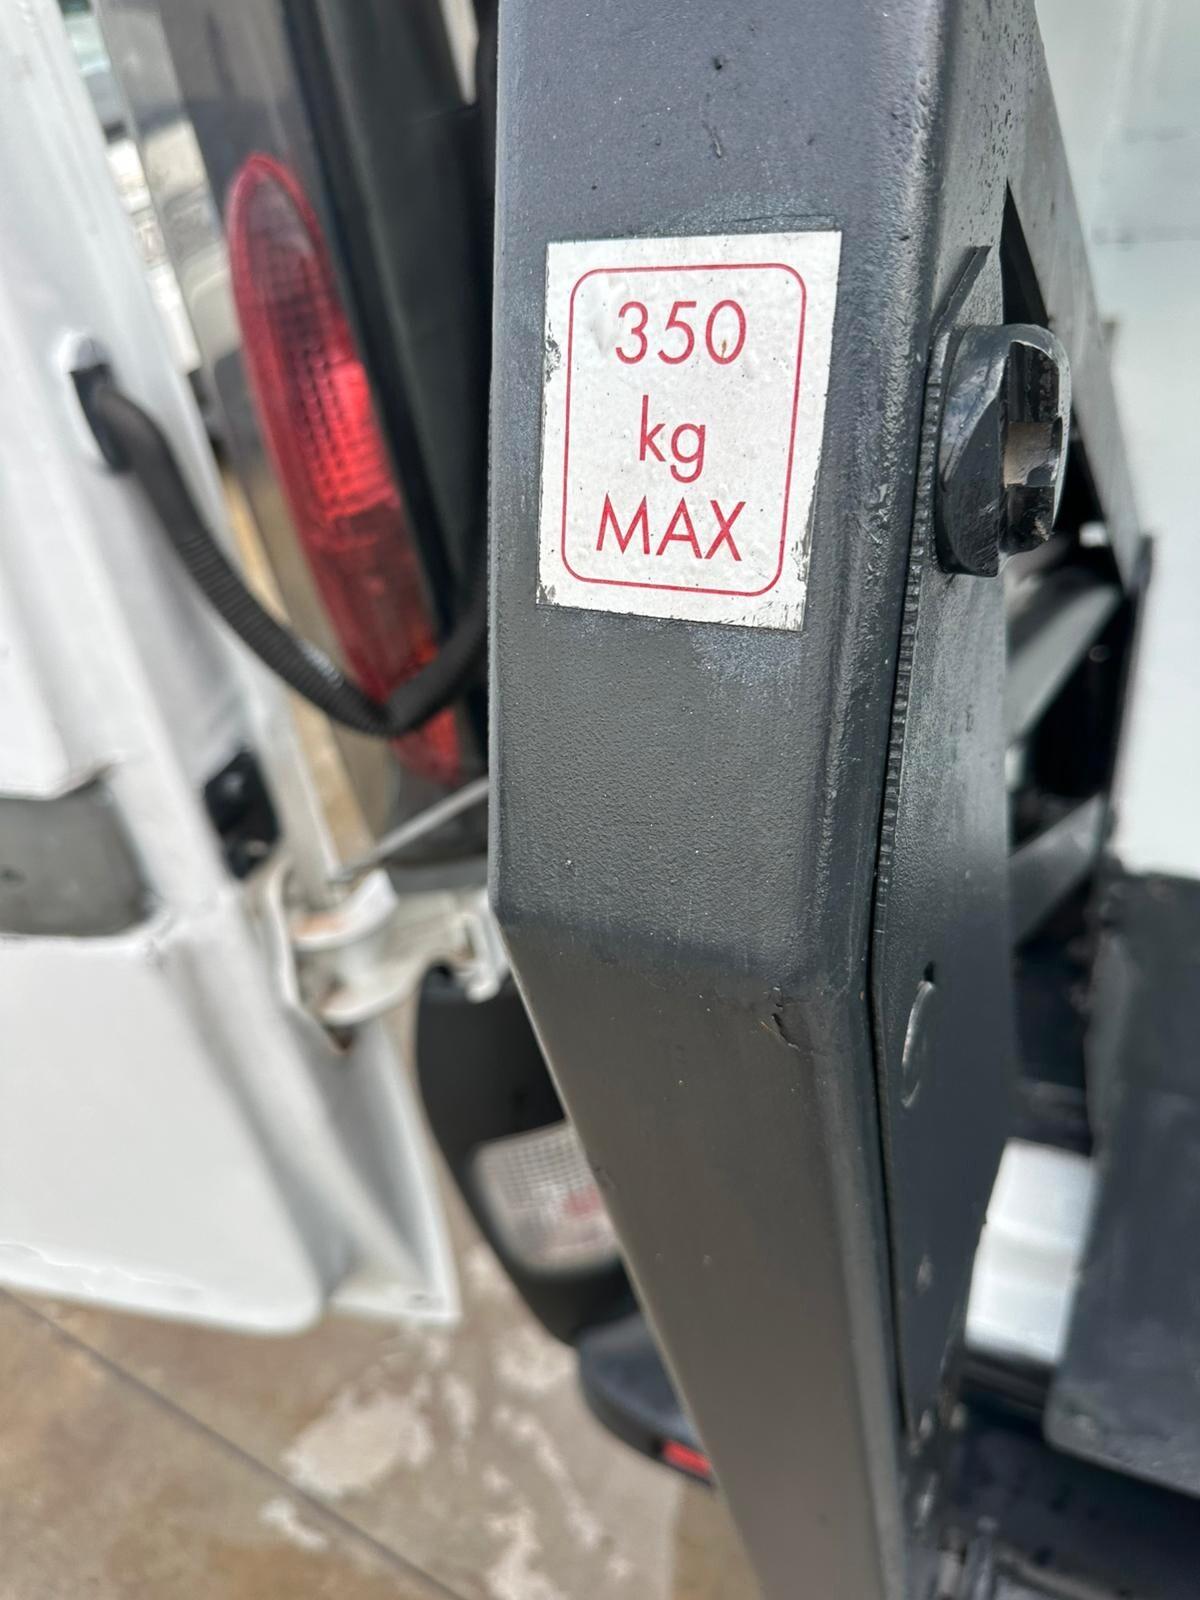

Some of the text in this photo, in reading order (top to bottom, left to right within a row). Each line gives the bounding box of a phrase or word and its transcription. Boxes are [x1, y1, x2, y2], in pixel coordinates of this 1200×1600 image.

[615, 299, 747, 365] 350
[638, 394, 707, 484] kg
[595, 494, 746, 562] MAX
